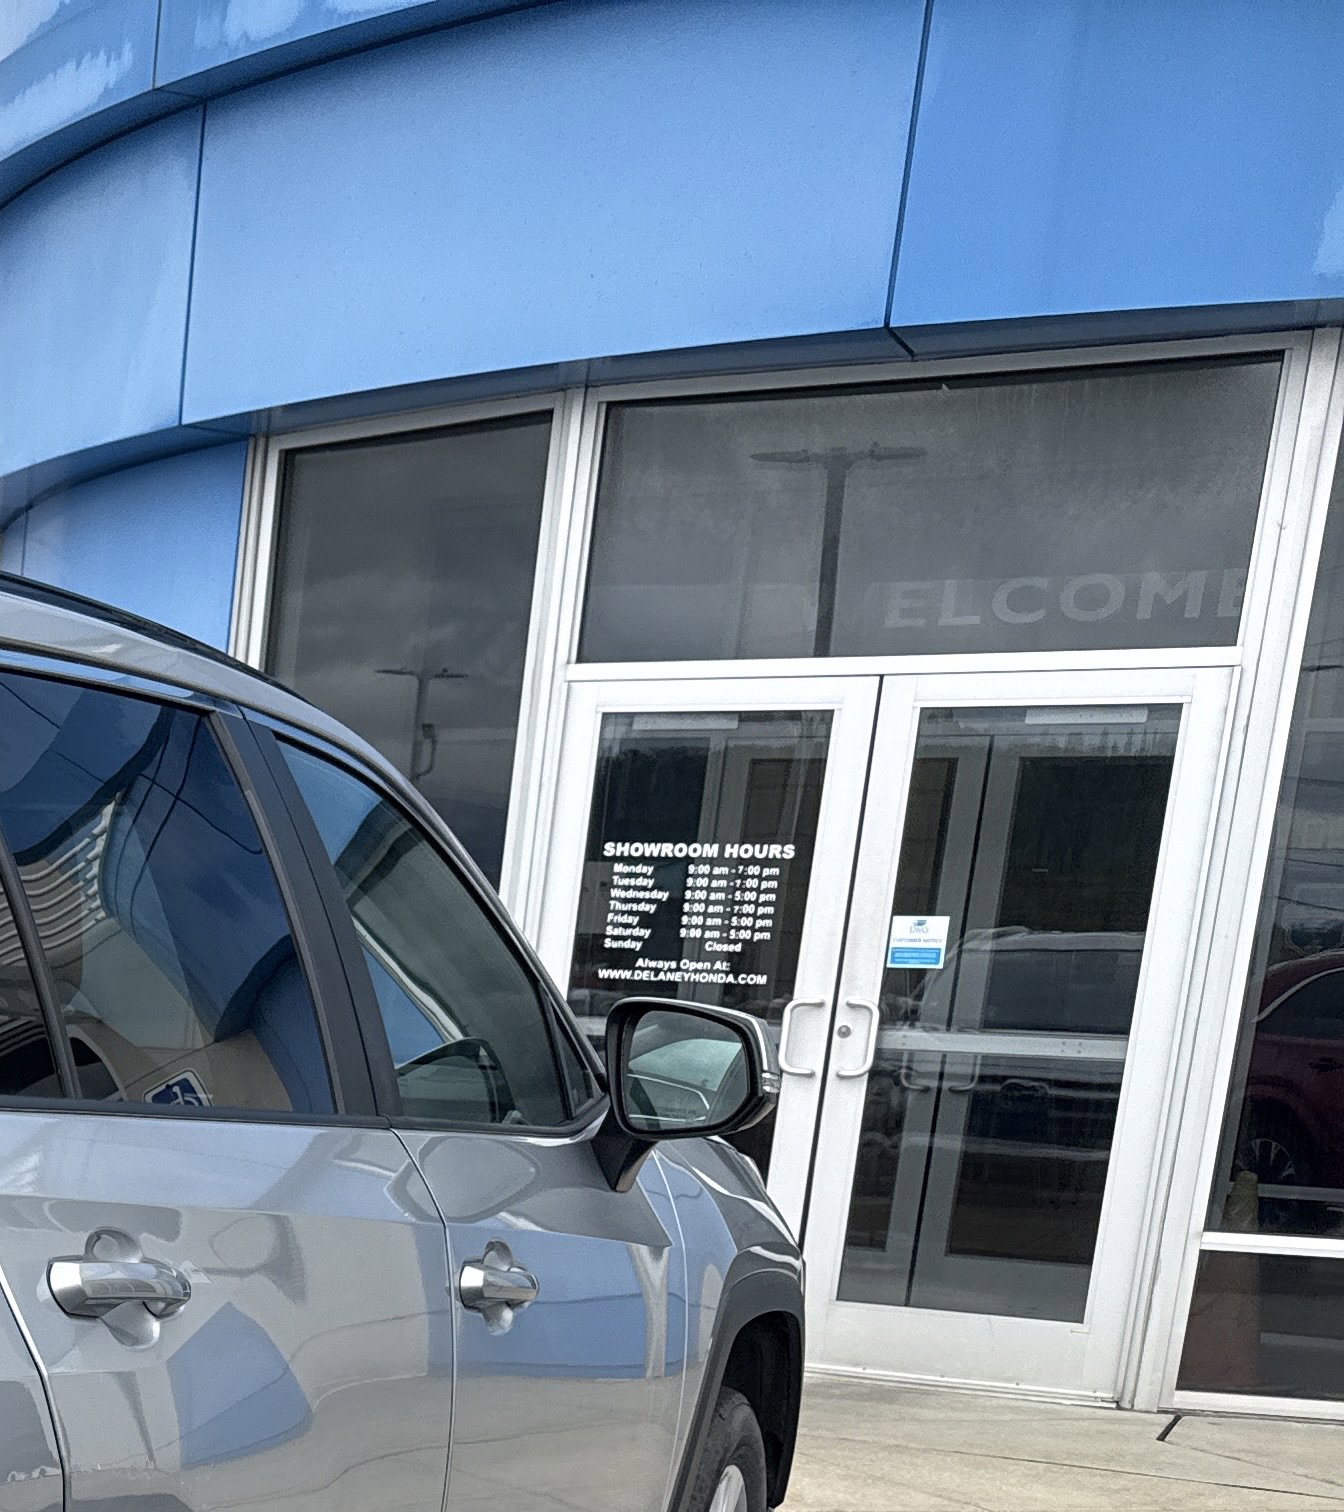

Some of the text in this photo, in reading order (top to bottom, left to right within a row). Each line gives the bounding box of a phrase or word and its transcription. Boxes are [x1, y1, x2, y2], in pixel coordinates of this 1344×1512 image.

[865, 568, 1248, 629] ELCOME
[603, 842, 795, 859] SHOWROOM HOURS
[613, 863, 654, 876] Monday
[687, 864, 711, 875] 9:00
[712, 866, 729, 875] am
[737, 865, 761, 876] 7:00
[762, 867, 780, 878] pm
[612, 875, 655, 889] Tuesday
[686, 877, 709, 888] 9:00
[710, 879, 728, 888] am
[760, 880, 778, 891] pm
[610, 888, 669, 901] Wednesday
[684, 889, 707, 900] 9:00
[708, 892, 726, 901] am
[758, 893, 776, 903] pm
[609, 900, 657, 914] Thursday
[682, 902, 705, 913] 9:00
[707, 904, 724, 913] am
[756, 906, 774, 916] pm
[606, 913, 639, 926] Friday
[681, 915, 704, 926] 9:00
[705, 917, 722, 926] am
[755, 919, 773, 929] pm
[605, 925, 652, 939] Saturday
[679, 927, 702, 938] 9:00
[703, 930, 720, 939] am
[753, 931, 771, 942] pm
[603, 938, 742, 952] Sunday Closed
[635, 958, 677, 971] Always
[679, 959, 711, 971] Open
[598, 968, 767, 985] WWW.DELANEYHONDA.COM
